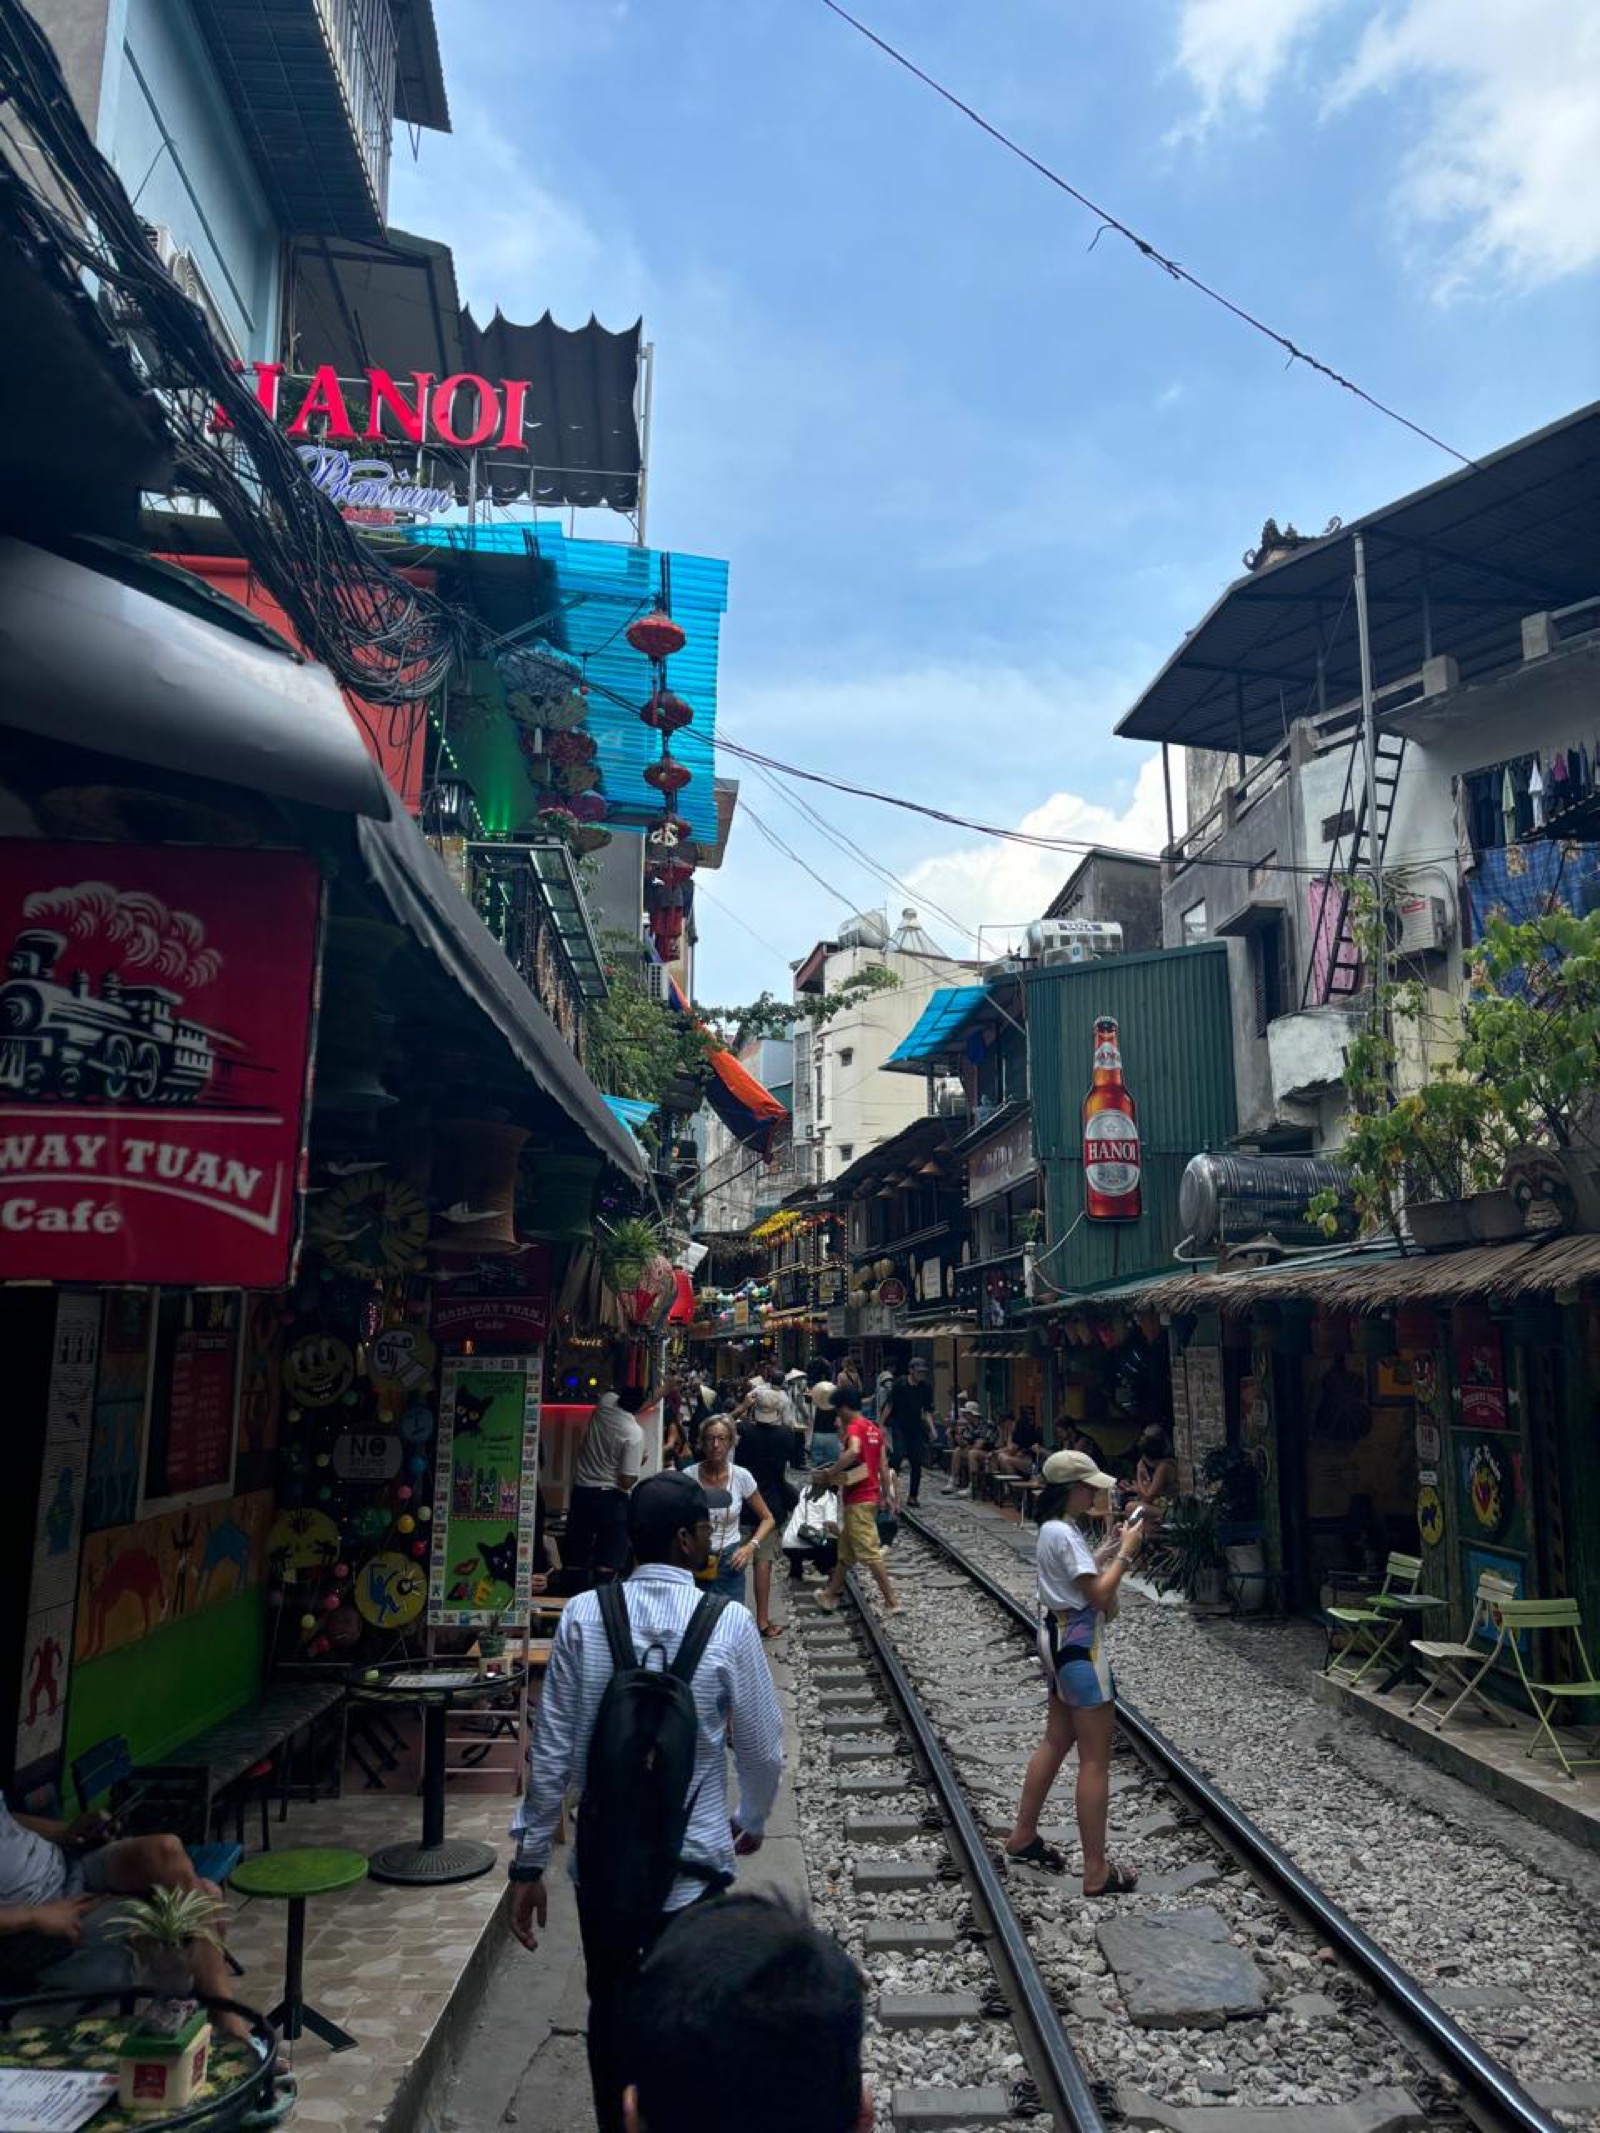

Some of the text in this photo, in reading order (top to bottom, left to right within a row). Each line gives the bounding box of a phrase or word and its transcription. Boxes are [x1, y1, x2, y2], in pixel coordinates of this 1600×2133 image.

[295, 445, 453, 514] Premium
[1088, 1141, 1136, 1160] HANOI
[122, 1139, 262, 1201] TUAN
[3, 1198, 123, 1233] Café
[350, 1437, 386, 1457] NO
